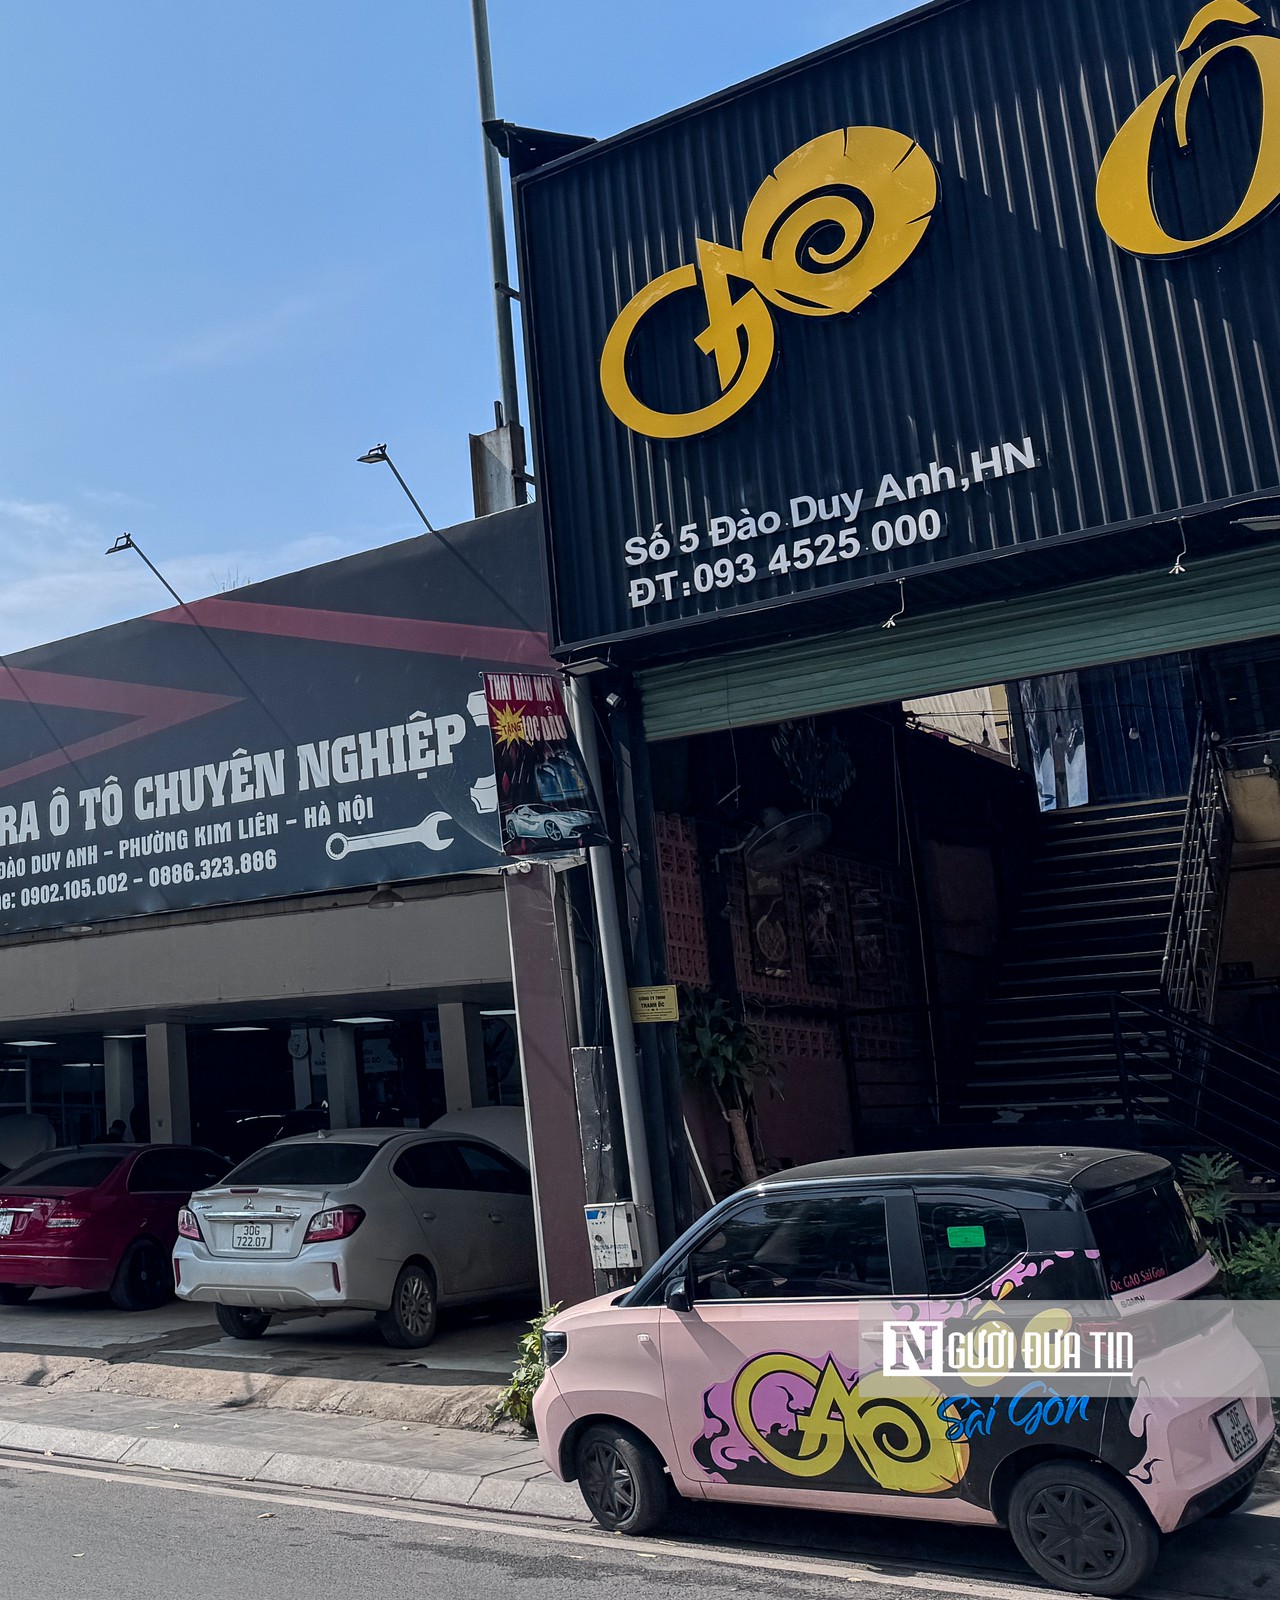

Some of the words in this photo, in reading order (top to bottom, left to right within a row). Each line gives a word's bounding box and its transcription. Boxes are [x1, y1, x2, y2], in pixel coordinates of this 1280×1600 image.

[624, 523, 671, 566] Số
[678, 527, 699, 554] 5
[708, 508, 781, 547] Đào
[789, 488, 864, 528] Duy
[768, 527, 861, 576] 4525
[871, 508, 942, 552] 000
[487, 674, 512, 700] THAY
[49, 785, 70, 837] Ô
[79, 775, 123, 831] TÔ
[134, 747, 286, 821] CHUYÊN
[296, 710, 467, 792] NGHIỆP
[31, 851, 61, 875] DUY
[65, 844, 98, 869] ANH
[119, 829, 188, 860] PHƯỜNG
[194, 821, 232, 848] KIM
[238, 811, 279, 840] LIÊN
[304, 800, 331, 829] HÀ
[337, 794, 374, 825] NỘI
[20, 871, 129, 907] 0902.105.002
[148, 848, 277, 888] 0886.323.886
[236, 1236, 267, 1247] 722.07
[243, 1225, 261, 1236] 30G
[936, 1392, 1001, 1443] Sài
[1008, 1380, 1090, 1437] Gòn
